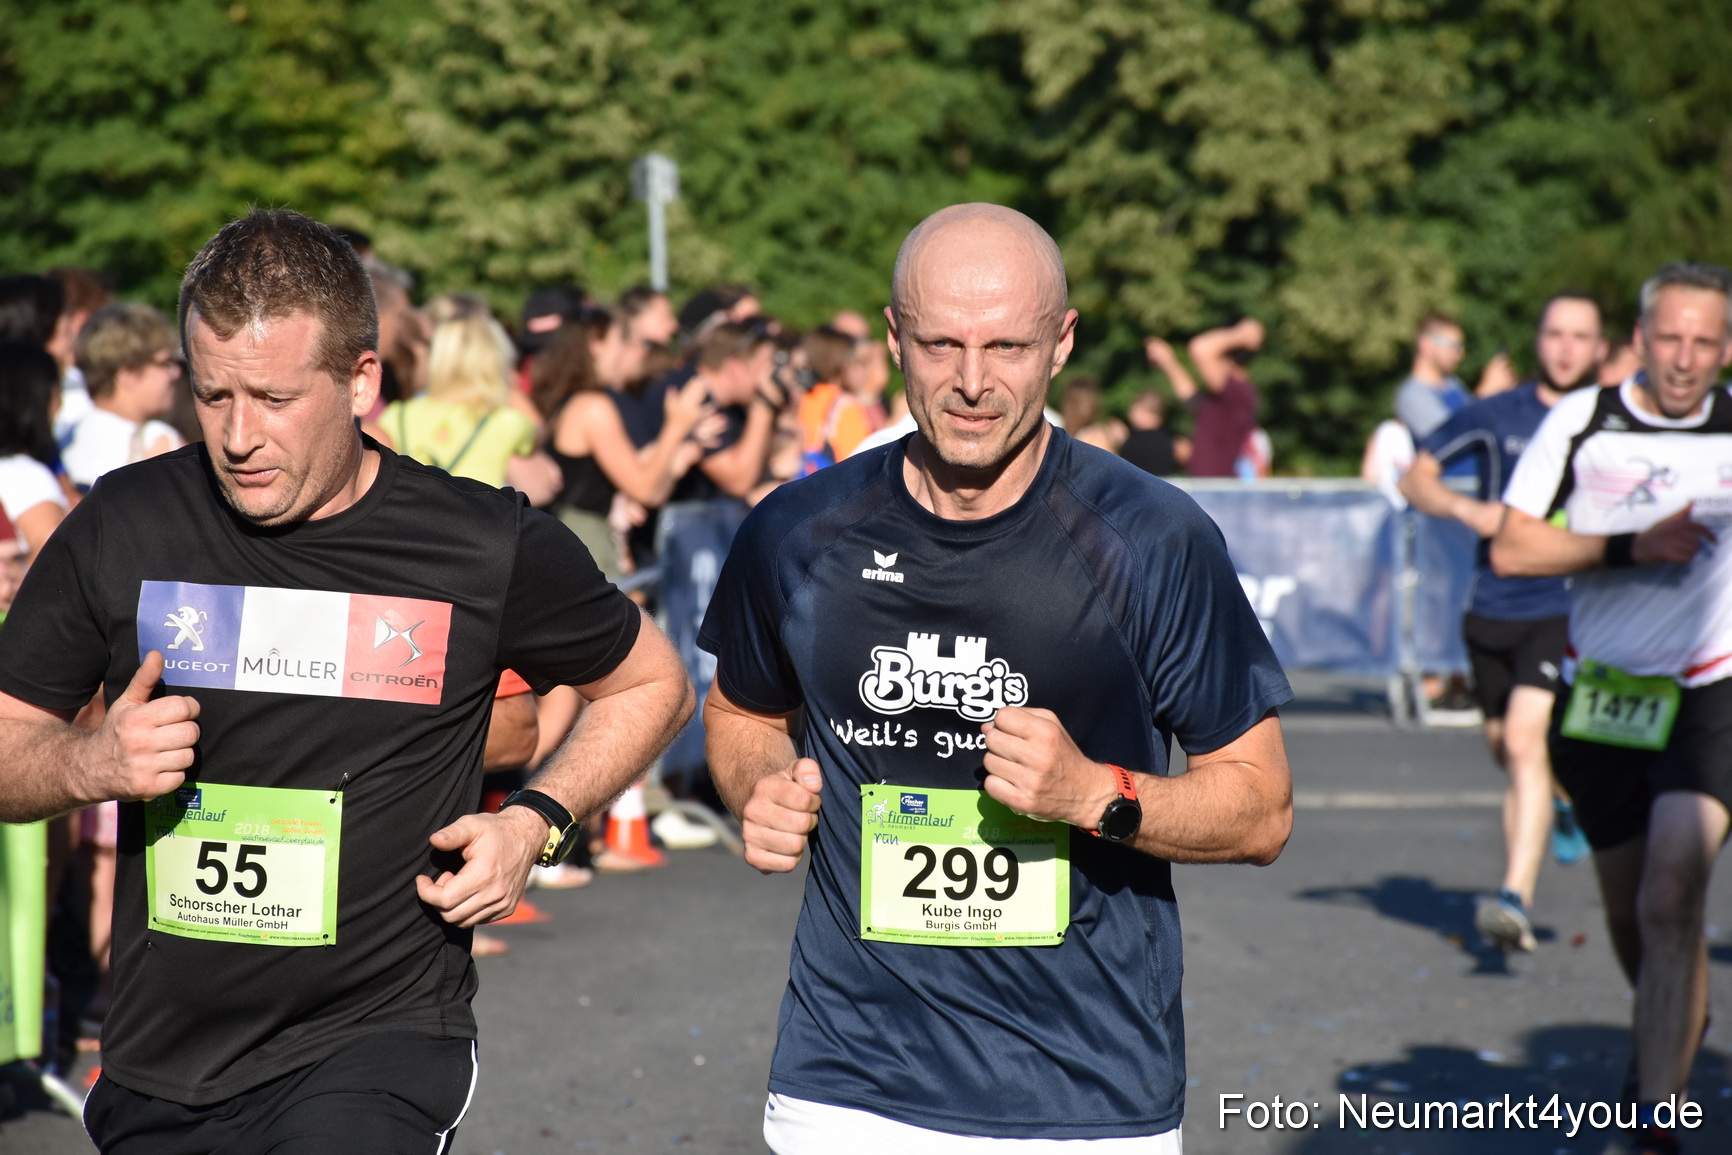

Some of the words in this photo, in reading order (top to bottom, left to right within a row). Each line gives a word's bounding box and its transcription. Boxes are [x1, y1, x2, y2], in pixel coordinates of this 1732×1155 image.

[862, 568, 904, 583] erima
[164, 659, 231, 673] UGEOT
[860, 646, 1027, 721] Burgis
[1585, 689, 1660, 725] 1471
[830, 718, 918, 747] Weil's
[887, 810, 954, 827] firmenlauf
[234, 822, 271, 836] 2018
[195, 841, 268, 898] 55
[902, 845, 1019, 901] 299
[169, 893, 247, 914] Schorscher
[252, 903, 302, 918] Lothar
[922, 904, 962, 917] Kube
[968, 905, 1002, 921] Ingo
[177, 911, 219, 925] Autohaus
[222, 914, 253, 927] Müller
[256, 920, 288, 930] GmbH
[926, 920, 960, 932] Burgis
[964, 921, 997, 930] GmbH
